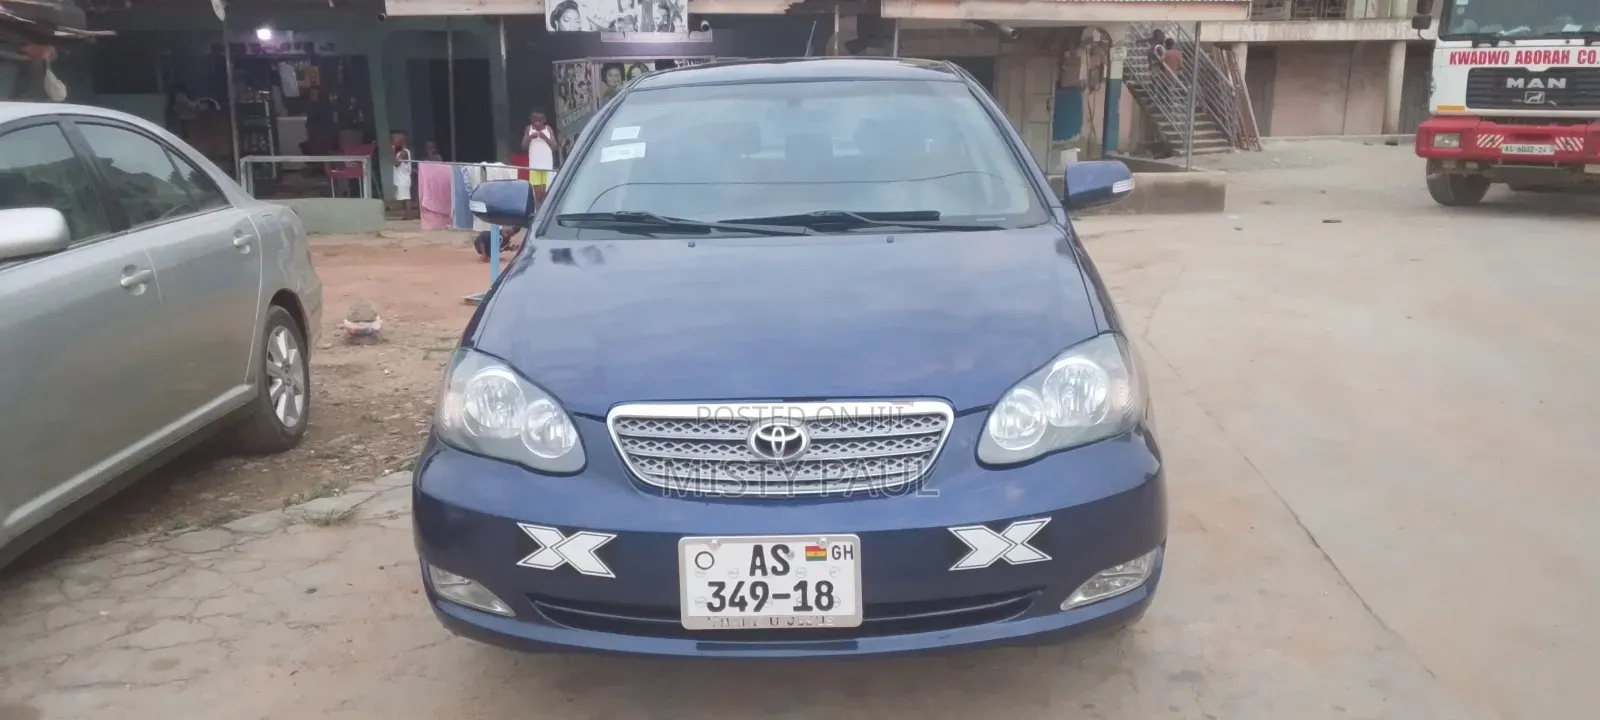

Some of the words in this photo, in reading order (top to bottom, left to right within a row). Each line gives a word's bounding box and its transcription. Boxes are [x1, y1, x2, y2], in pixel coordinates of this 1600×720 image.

[1449, 51, 1510, 65] KWADWO
[1514, 50, 1571, 65] ABORAH
[1506, 77, 1568, 89] MAN
[749, 544, 790, 576] AS
[831, 545, 854, 561] GH
[706, 580, 834, 612] 349-18
